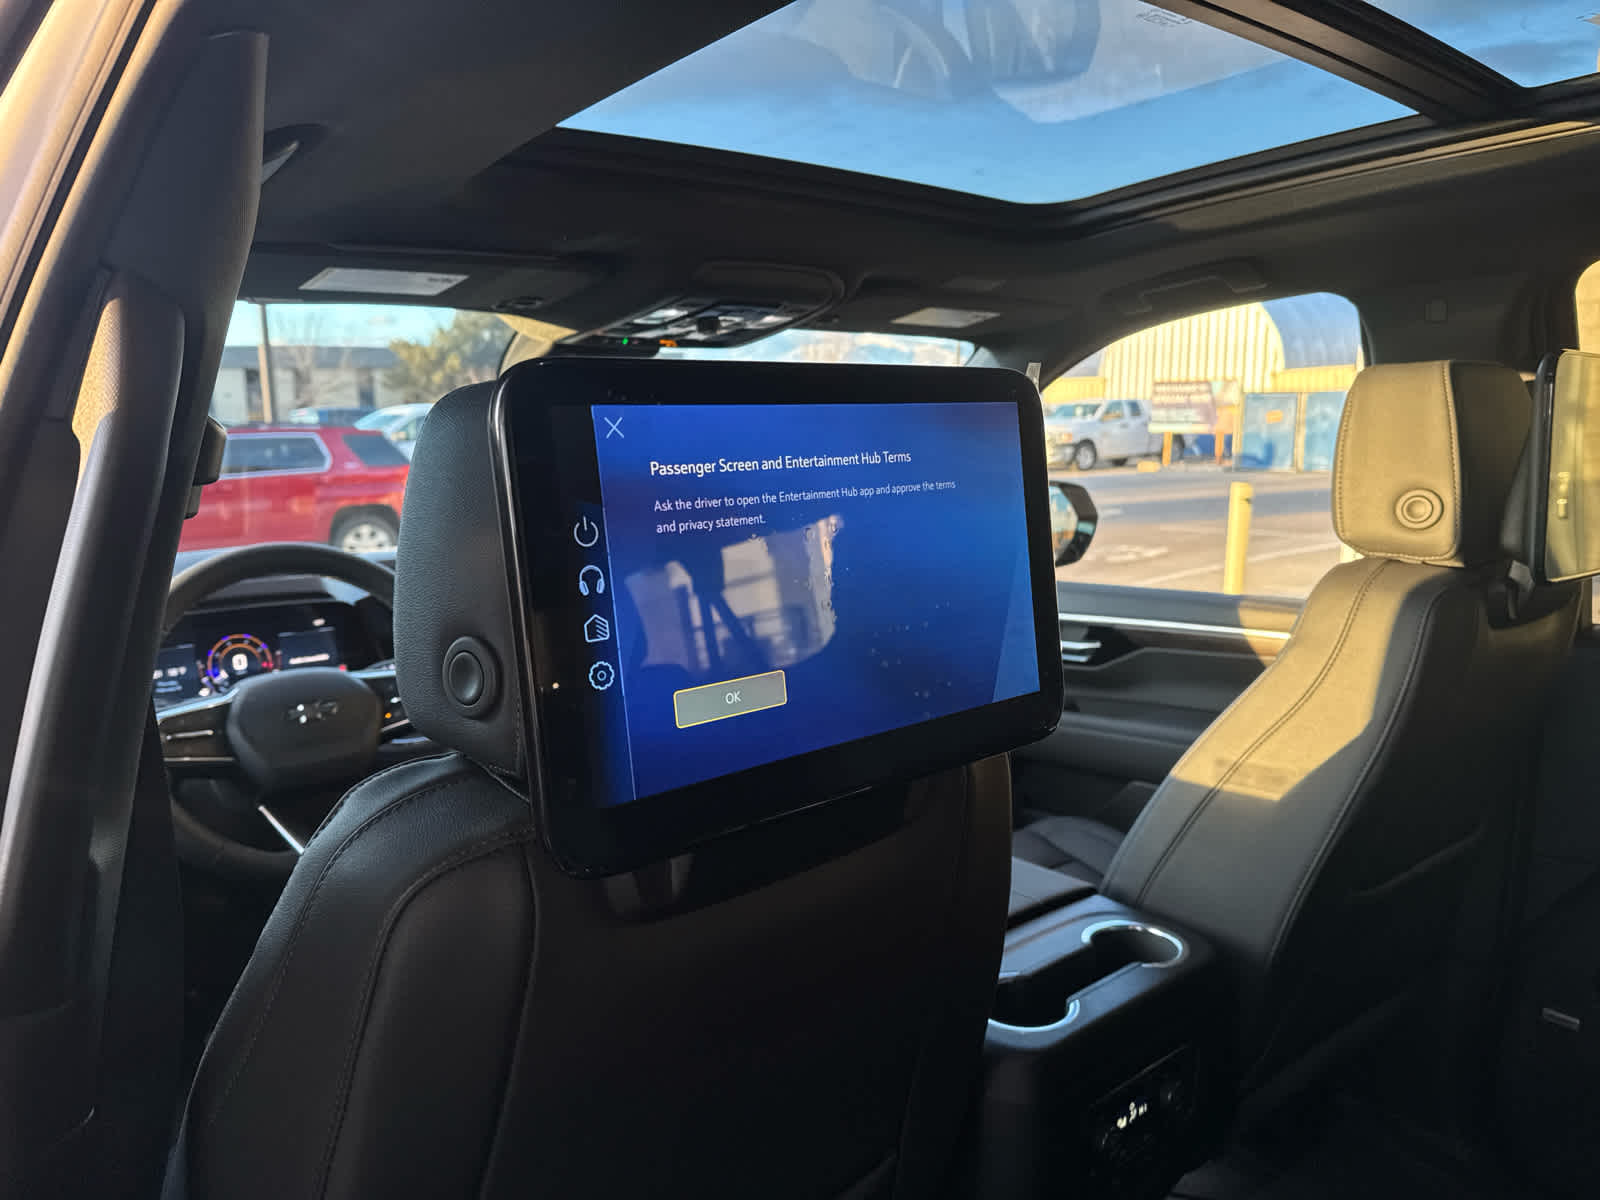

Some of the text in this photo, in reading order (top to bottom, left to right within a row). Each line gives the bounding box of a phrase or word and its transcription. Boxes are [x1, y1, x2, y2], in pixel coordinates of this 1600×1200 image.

[650, 450, 912, 478] Passenger Screen and Entertainment Hub Terms
[654, 480, 956, 512] Ask the driver to open the Entertainment Hub app and approve the terms
[656, 514, 767, 534] and privacy statement.
[725, 691, 742, 704] OK
